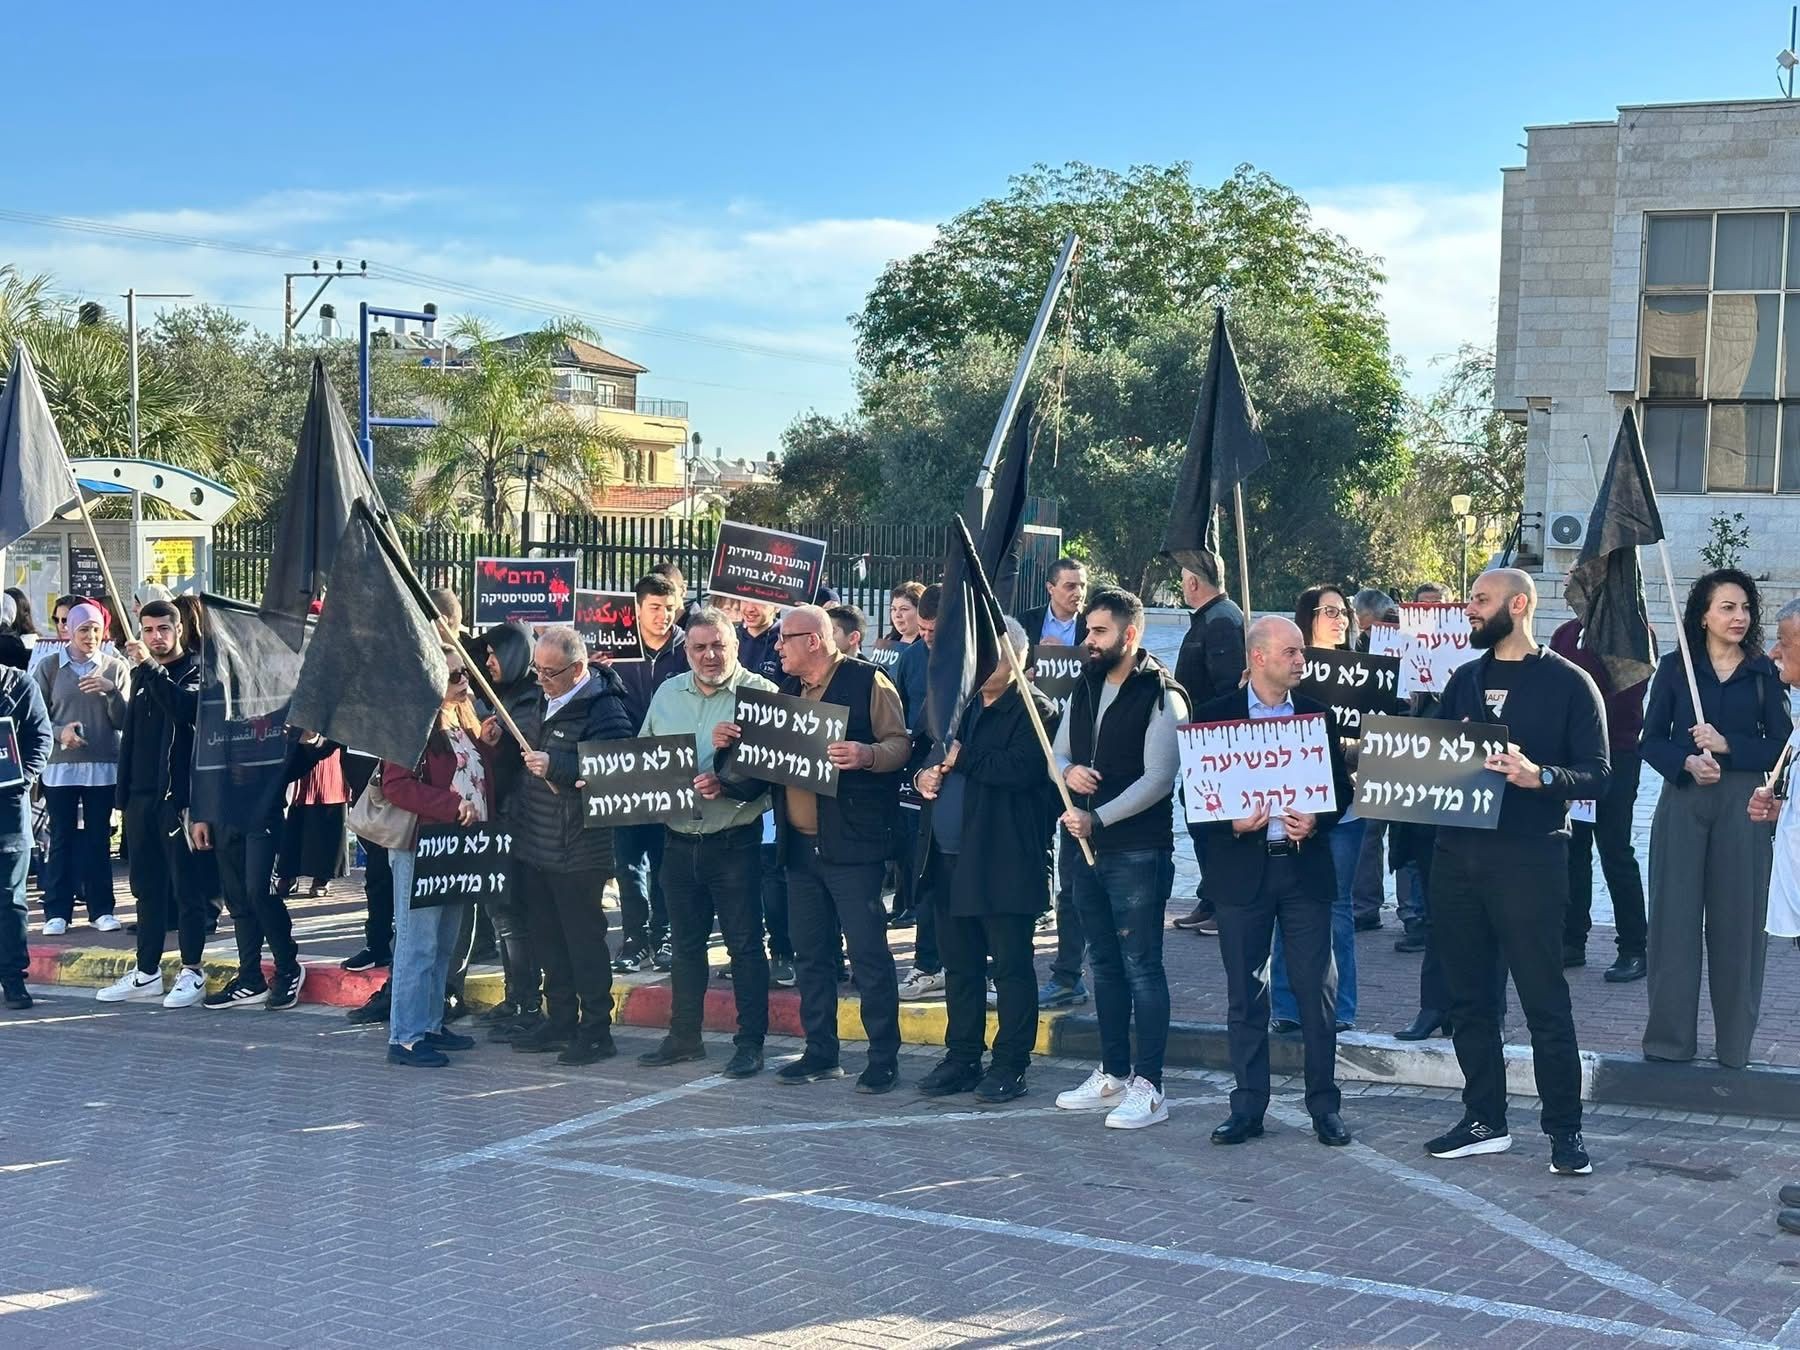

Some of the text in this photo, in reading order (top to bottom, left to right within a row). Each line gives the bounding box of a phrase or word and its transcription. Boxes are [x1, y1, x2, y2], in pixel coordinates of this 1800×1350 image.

[727, 545, 811, 572] התערבות מיידית
[507, 570, 546, 584] הדם
[727, 564, 804, 589] חובה לא בחירה
[481, 592, 570, 606] אינו סטטיסטיקה
[598, 629, 638, 650] شبابنا
[1416, 631, 1469, 650] שיעה
[870, 648, 900, 666] טעות
[1035, 657, 1082, 679] טעות
[1300, 660, 1395, 691] זו לא טע
[736, 700, 844, 741] זו לא טעות
[1299, 744, 1324, 765] די
[1361, 730, 1431, 759] טעות
[1438, 731, 1476, 763] לא
[581, 744, 695, 776] זו לא טעות
[736, 741, 833, 783] זו מדיניות
[588, 787, 695, 817] זו מדיניות
[1240, 783, 1329, 810] די להרג
[1360, 779, 1495, 815] זו מדיניות
[417, 829, 513, 858] זו לא טעות
[414, 872, 506, 897] זו מדיניות
